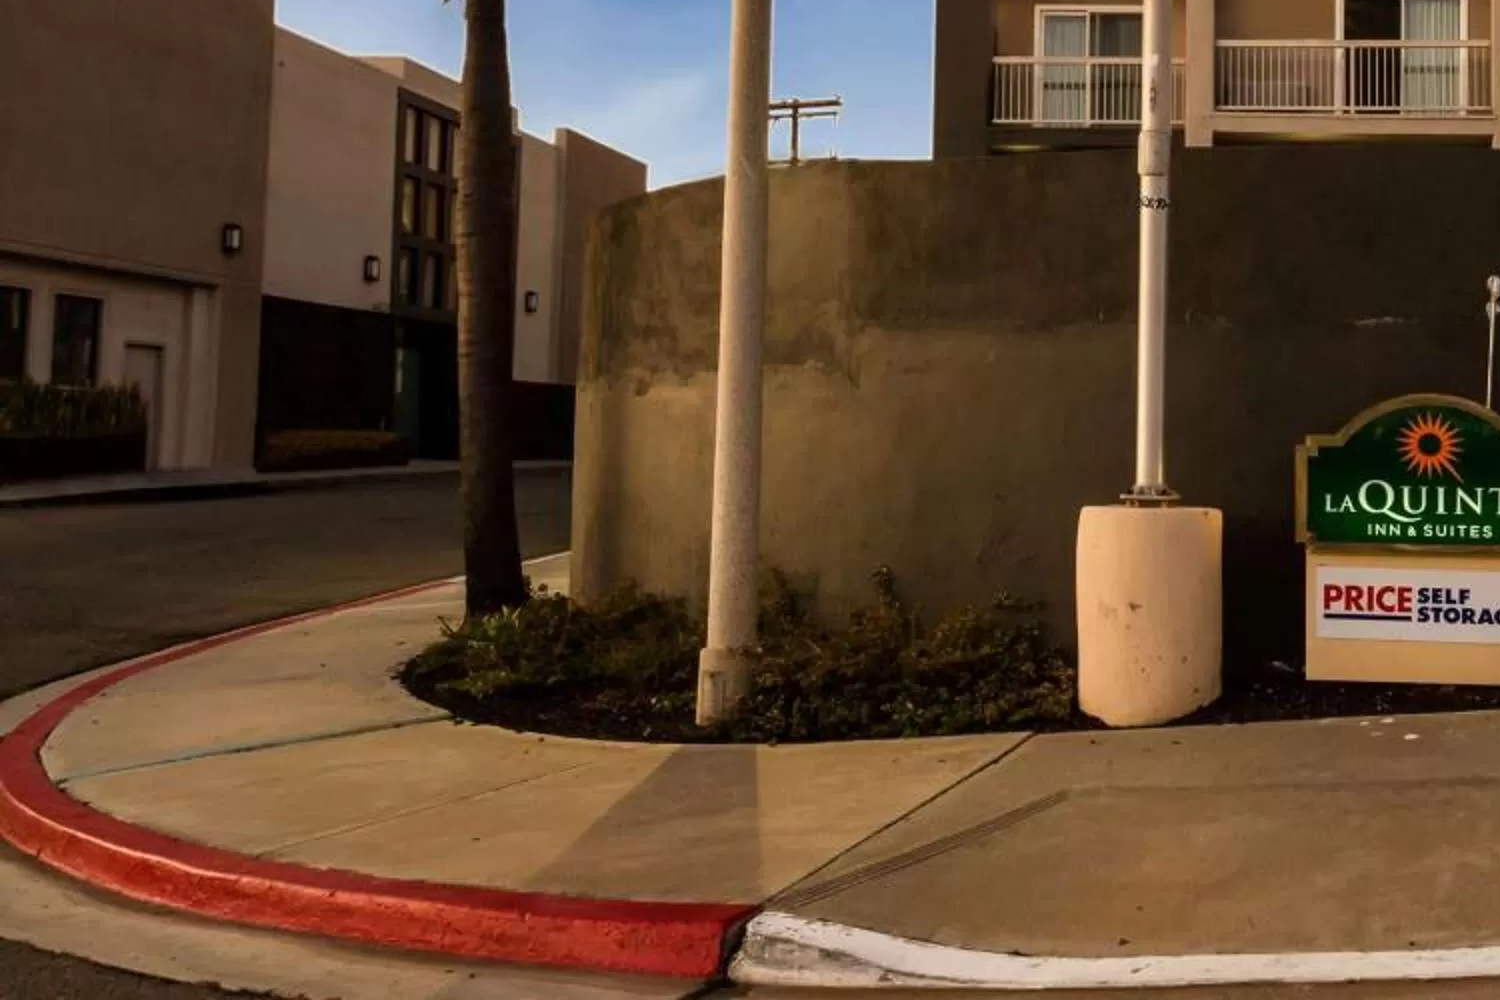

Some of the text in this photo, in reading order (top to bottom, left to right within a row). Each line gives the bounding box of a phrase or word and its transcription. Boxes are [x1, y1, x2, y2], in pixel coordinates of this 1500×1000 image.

[1324, 493, 1357, 513] LA
[1367, 523, 1493, 539] INN & SUITES
[1323, 584, 1412, 613] PRICE
[1417, 587, 1471, 605] SELF
